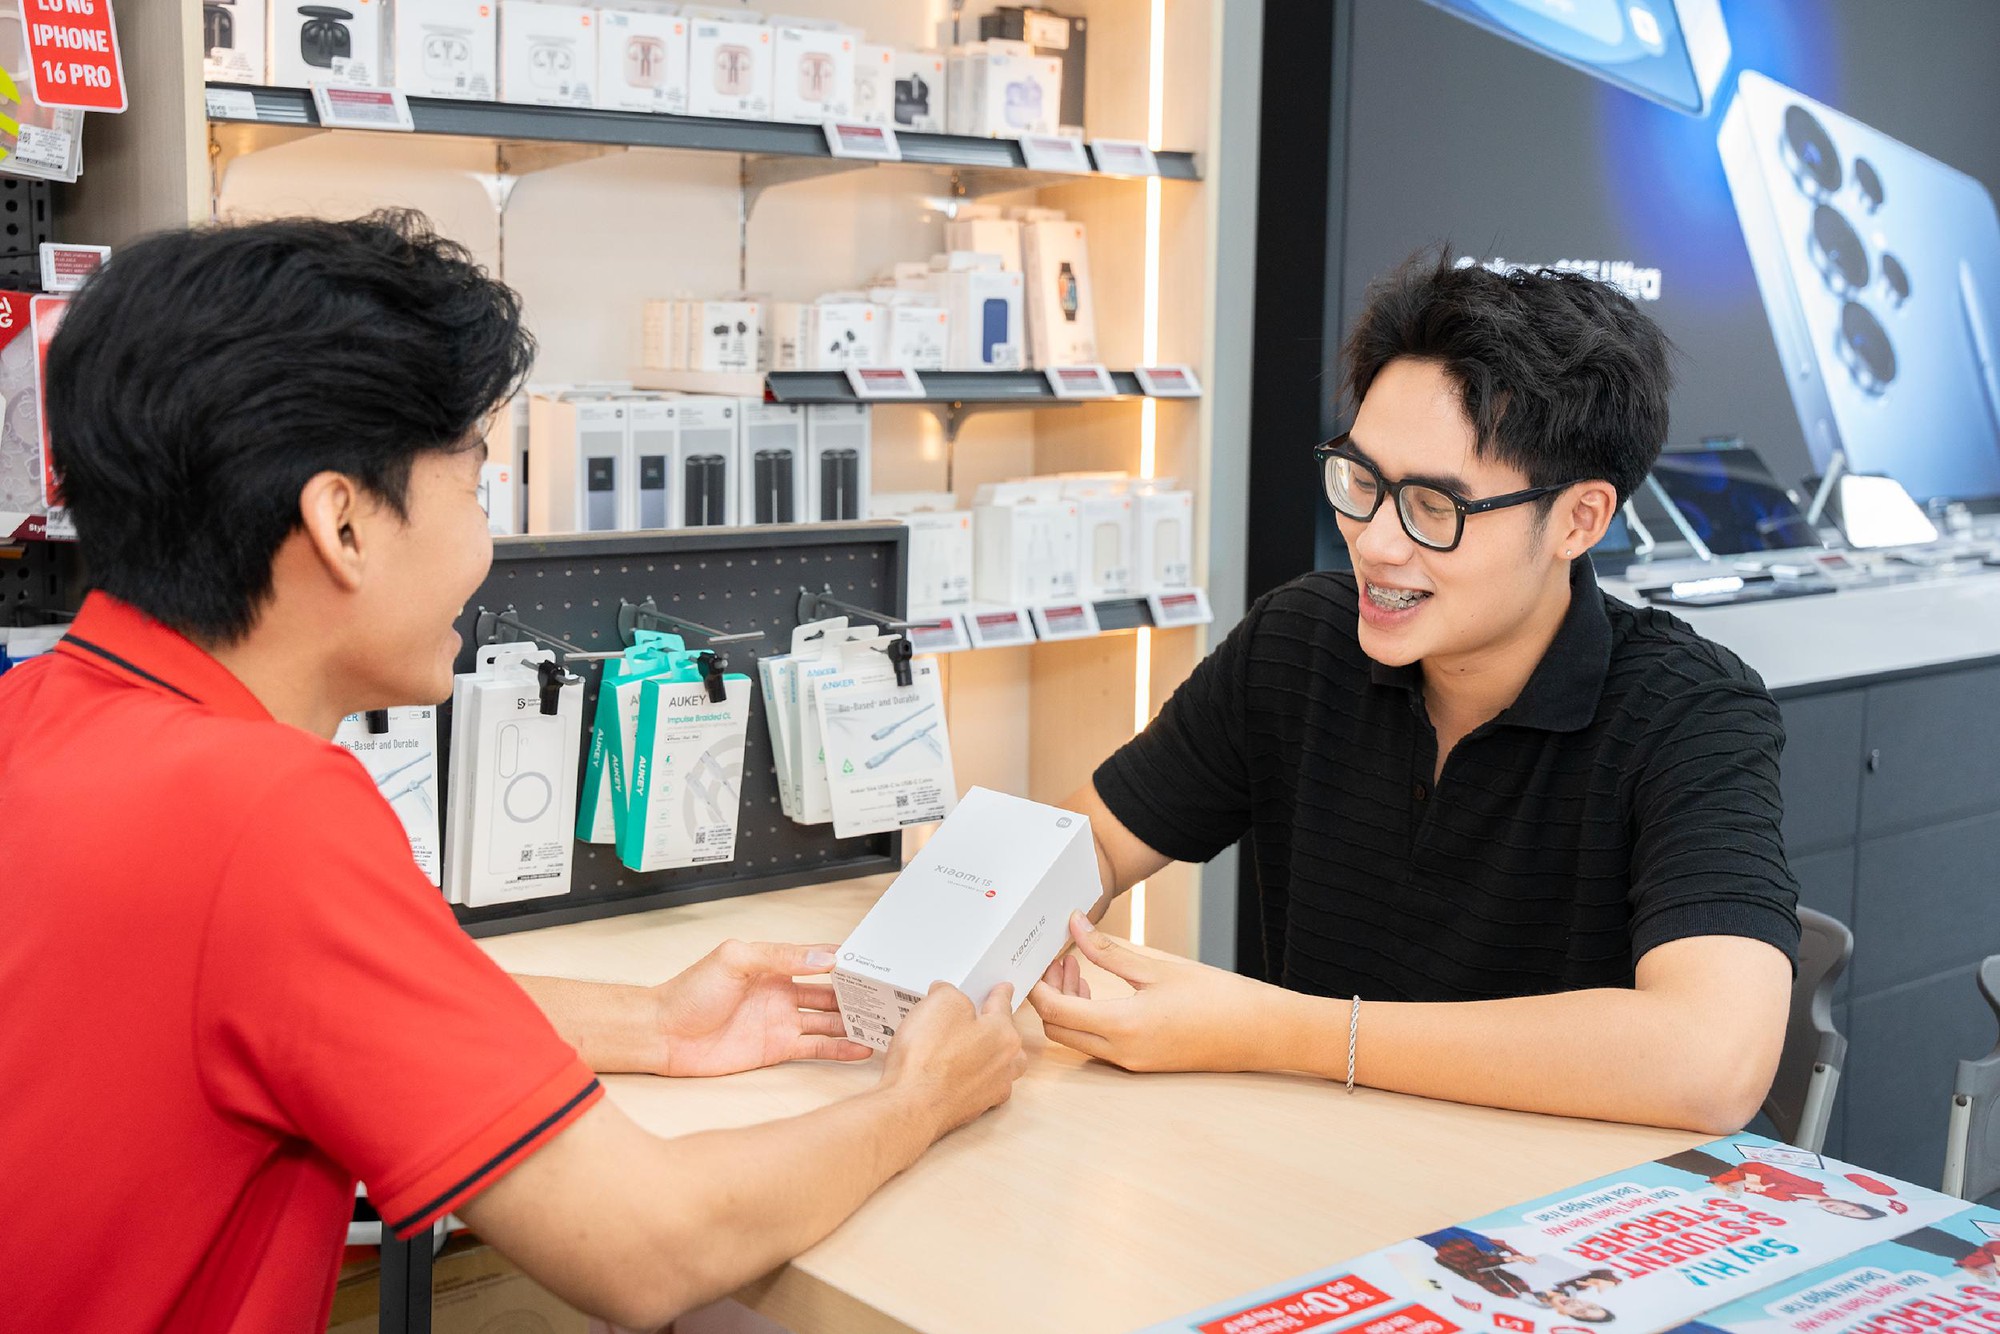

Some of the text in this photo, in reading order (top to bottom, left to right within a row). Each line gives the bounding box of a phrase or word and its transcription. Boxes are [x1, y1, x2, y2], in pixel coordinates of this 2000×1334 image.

[33, 23, 109, 53] IPHONE
[42, 60, 111, 88] 16 PRO
[821, 678, 855, 690] ANKER
[669, 695, 706, 707] AUKEY
[394, 738, 419, 749] Durable
[592, 728, 605, 768] AUKEY
[611, 754, 622, 793] AUKEY
[634, 755, 647, 796] AUKEY
[982, 878, 993, 888] 15
[1723, 1238, 1799, 1265] Say
